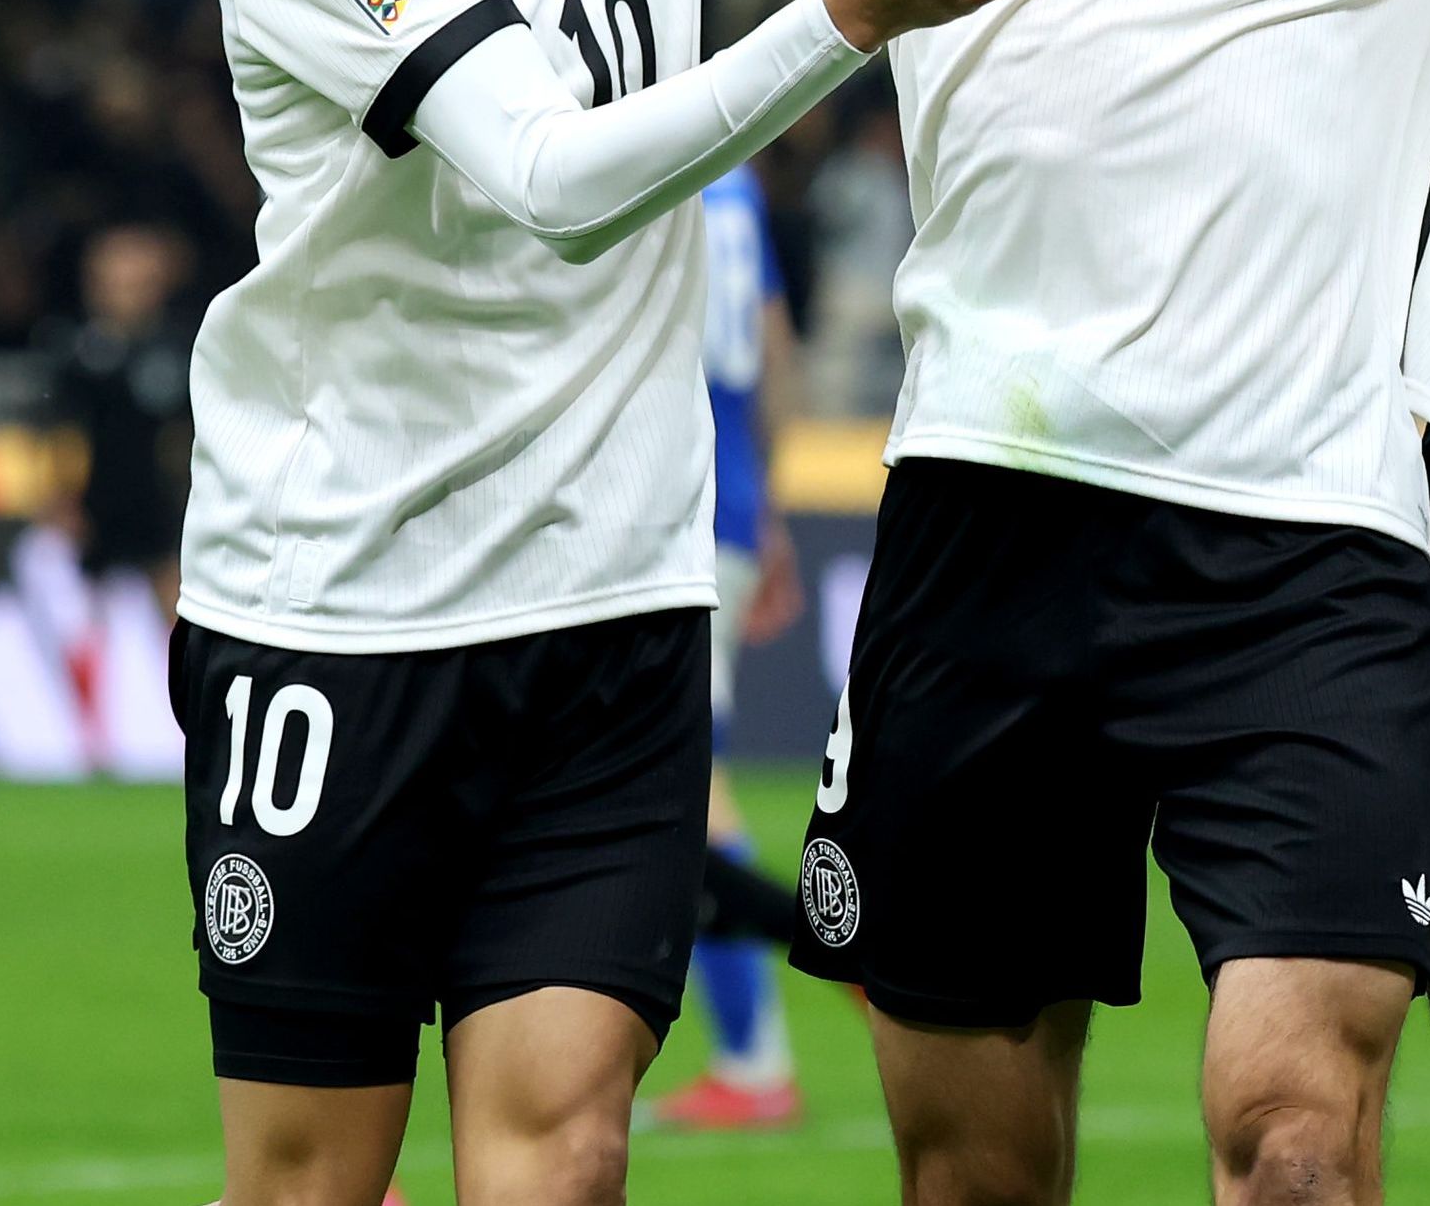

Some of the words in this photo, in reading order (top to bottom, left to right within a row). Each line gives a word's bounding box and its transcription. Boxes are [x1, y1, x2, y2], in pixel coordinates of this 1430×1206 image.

[219, 674, 334, 837] 10
[229, 859, 269, 953] FUSSBALL-BUND
[818, 843, 856, 936] FUSSBALL-BUND
